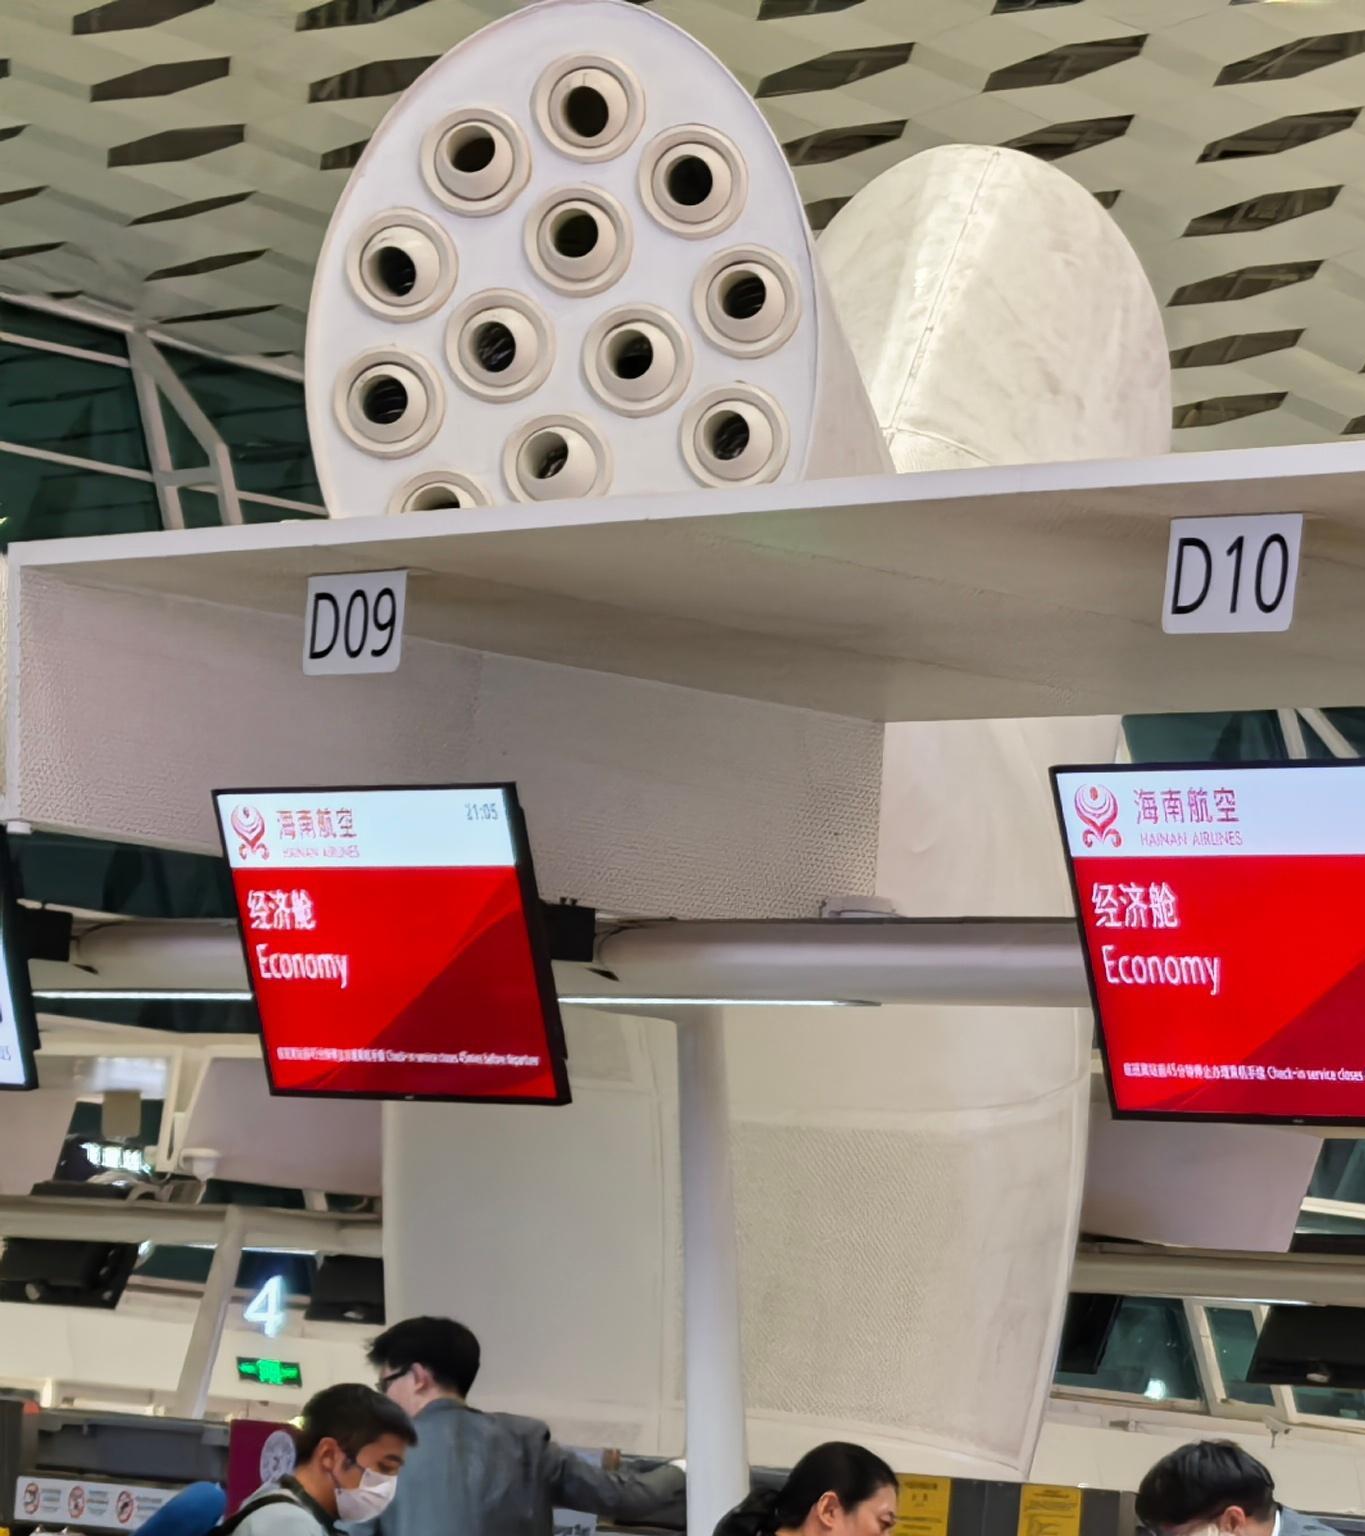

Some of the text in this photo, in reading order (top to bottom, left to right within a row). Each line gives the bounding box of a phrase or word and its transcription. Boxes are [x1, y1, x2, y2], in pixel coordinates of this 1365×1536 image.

[1171, 533, 1289, 614] D10
[308, 586, 397, 660] D09
[1133, 787, 1240, 824] 海南航空
[1091, 881, 1180, 929] 经济舱
[255, 943, 349, 989] Economy
[1101, 944, 1221, 996] Economy
